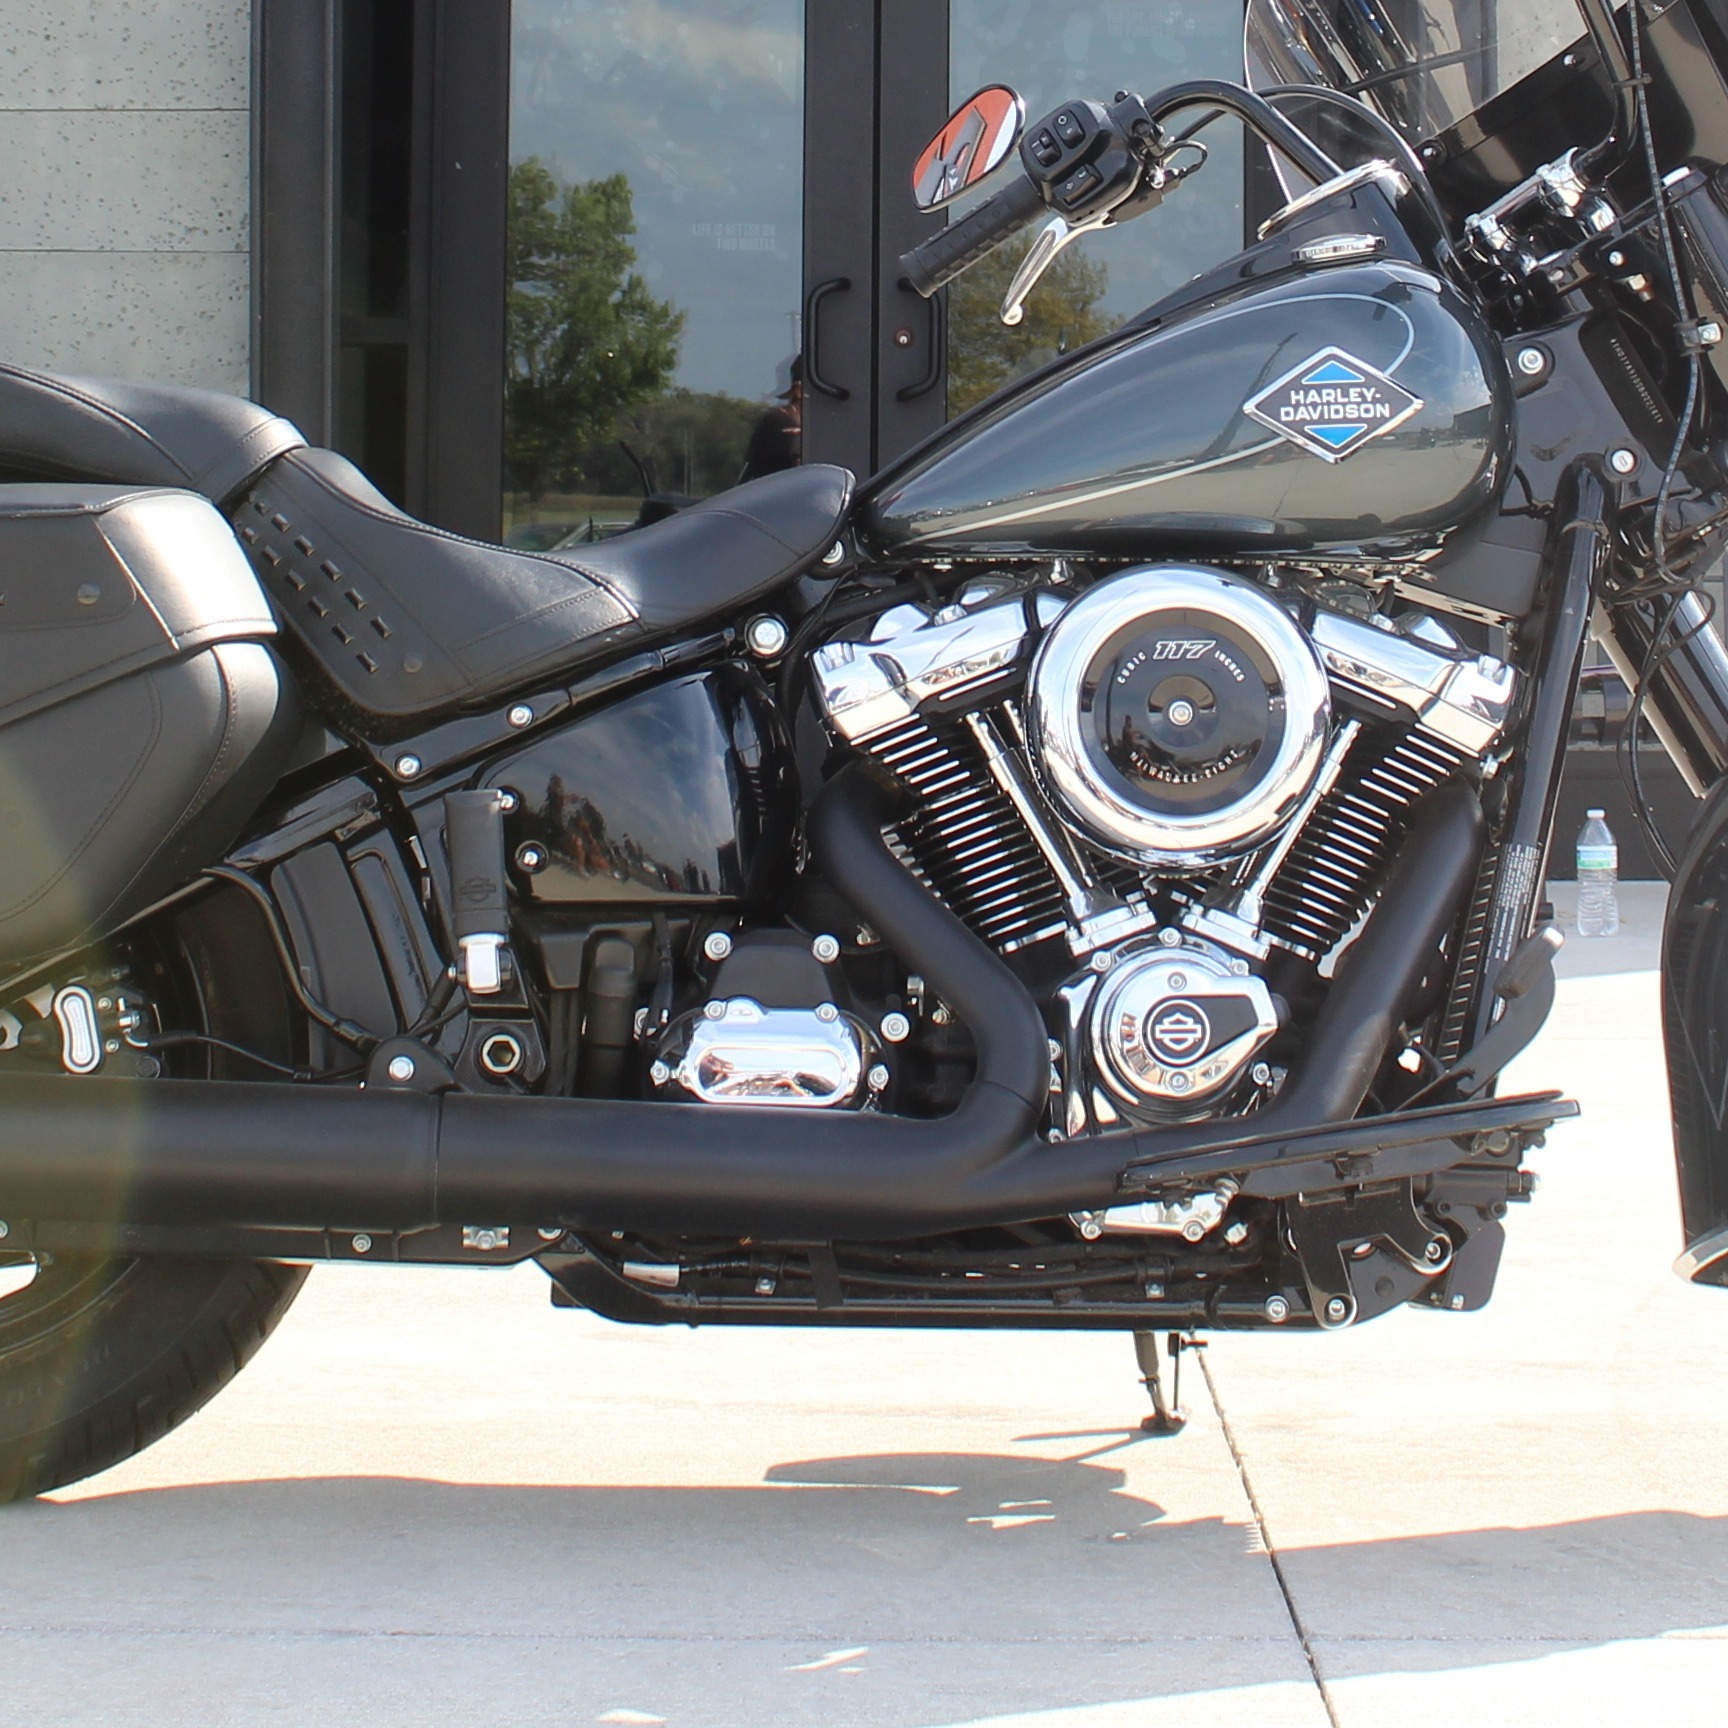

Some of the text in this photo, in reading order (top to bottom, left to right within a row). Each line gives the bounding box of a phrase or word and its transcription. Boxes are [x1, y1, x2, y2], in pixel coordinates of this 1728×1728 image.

[1290, 386, 1381, 405] HARLEY-
[1280, 402, 1391, 422] DAVIDSON
[1116, 640, 1247, 684] CUBIC 117 INCHES
